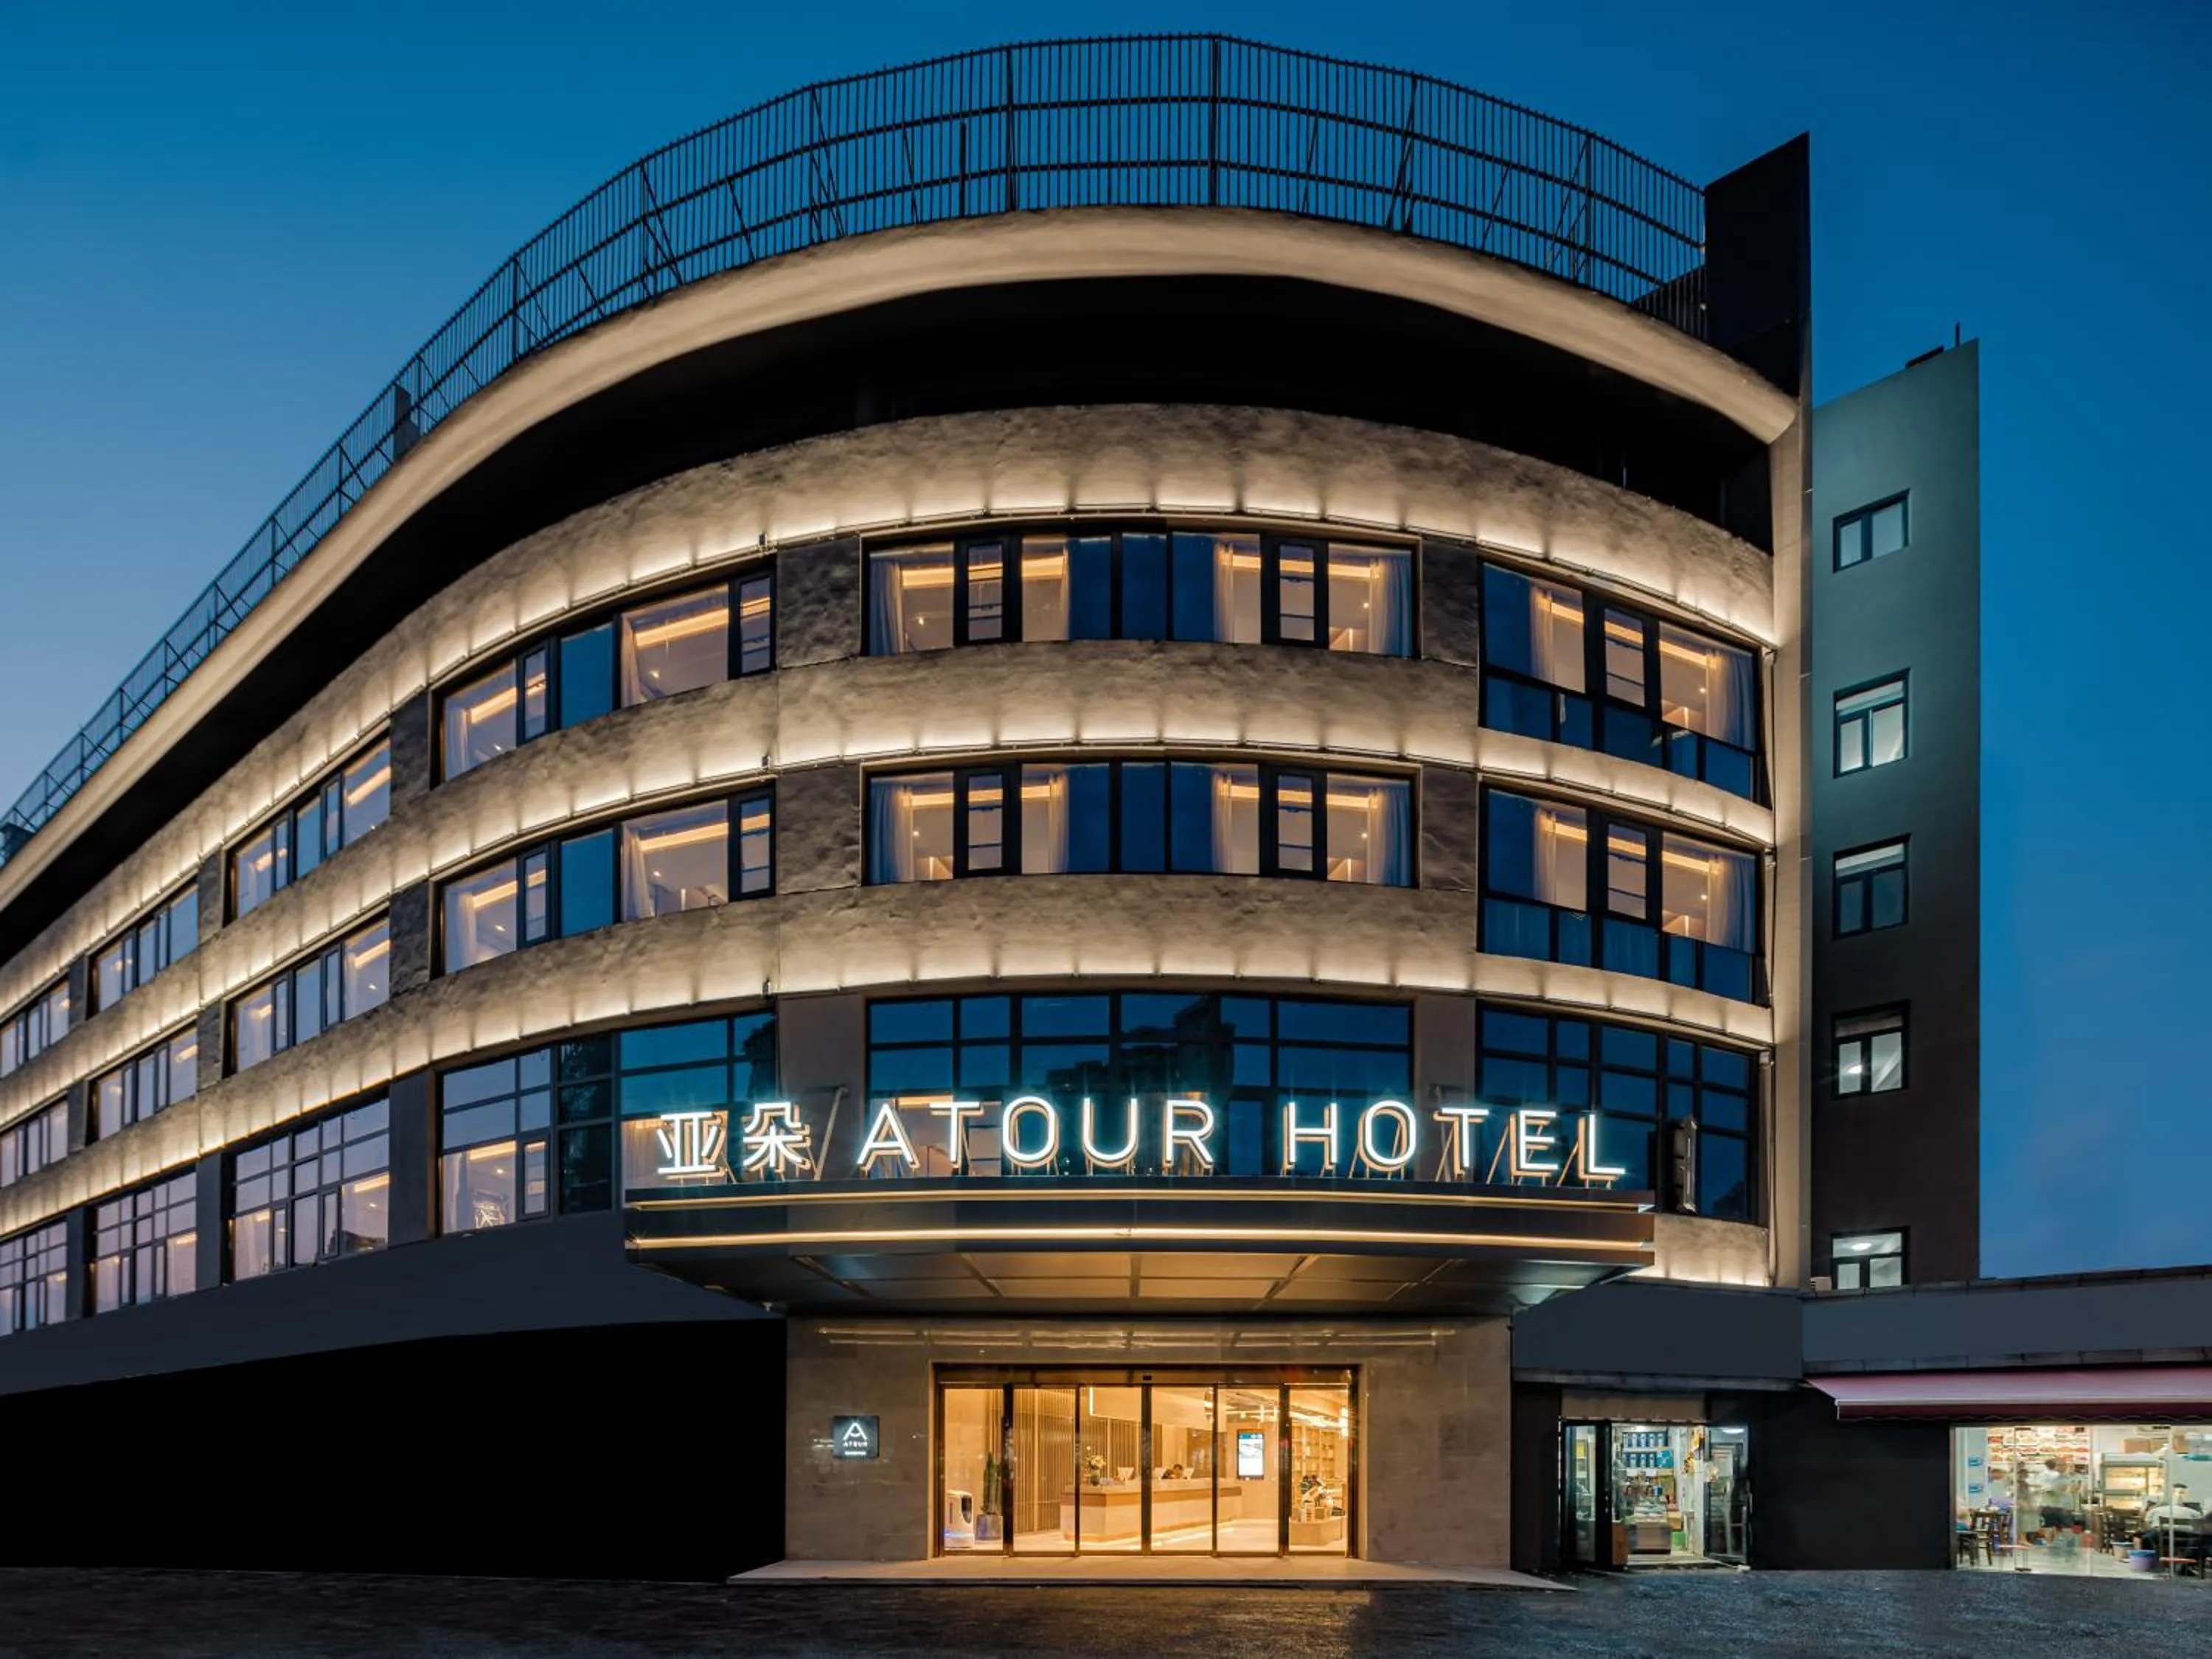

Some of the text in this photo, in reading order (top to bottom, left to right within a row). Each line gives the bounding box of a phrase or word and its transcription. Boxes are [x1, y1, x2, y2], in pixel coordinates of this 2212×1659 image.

[656, 1096, 1626, 1178] 亚朵 ATOUR HOTEL
